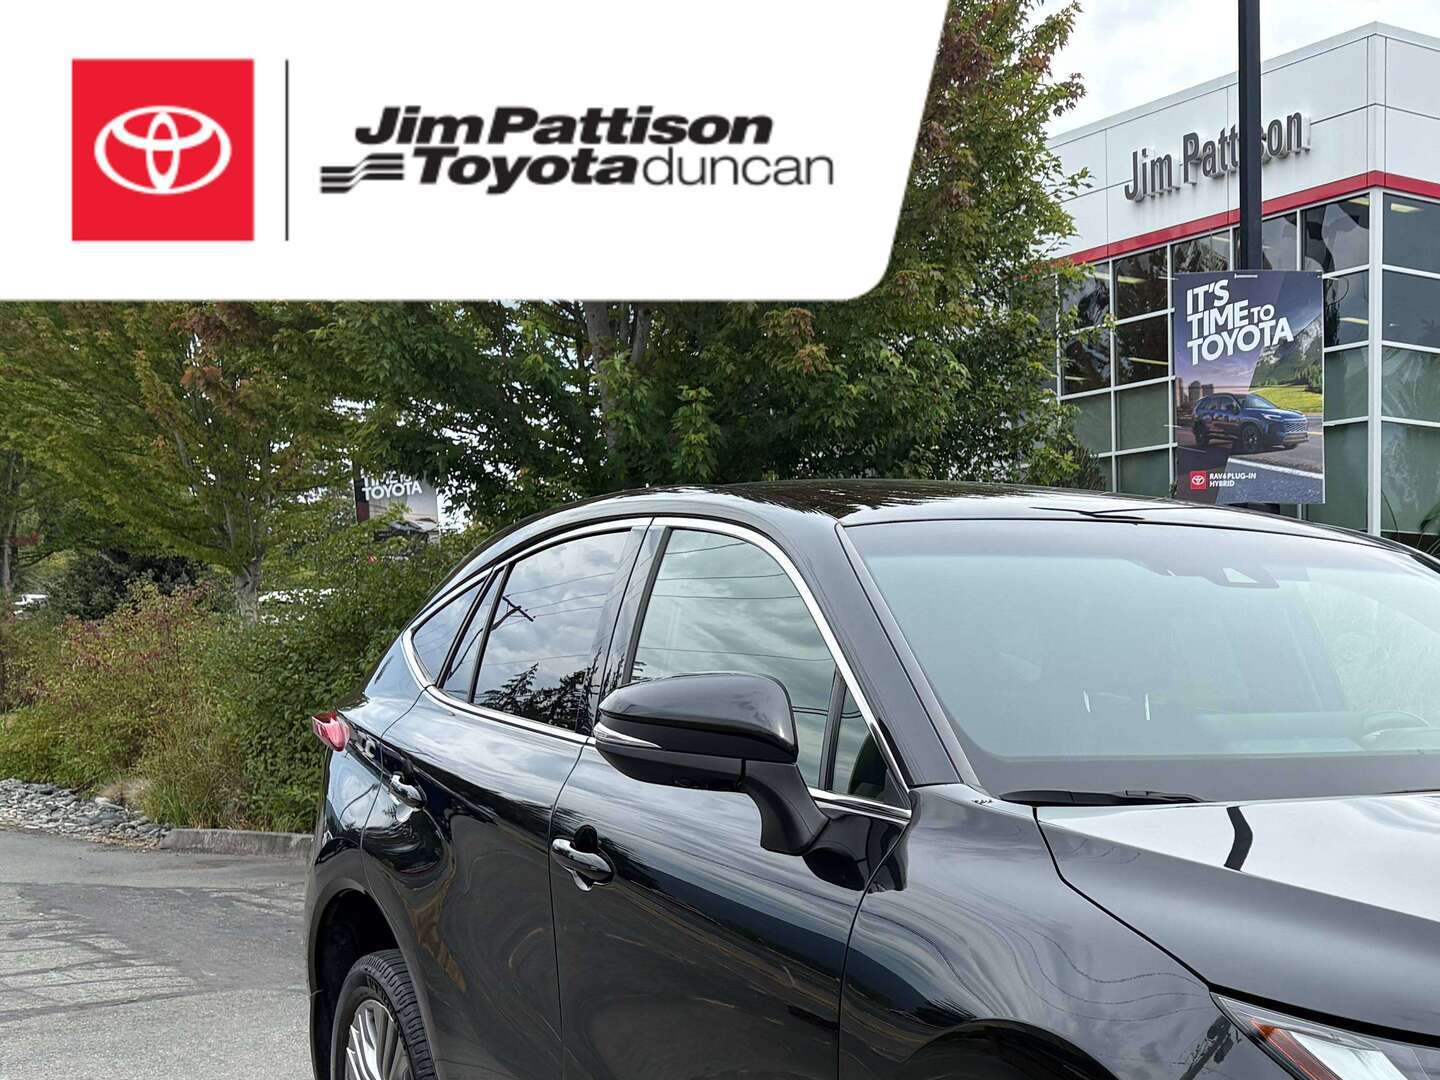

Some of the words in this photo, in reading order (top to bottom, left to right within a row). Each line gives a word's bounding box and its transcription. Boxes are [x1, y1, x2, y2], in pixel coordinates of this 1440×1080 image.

[1124, 148, 1175, 201] Jim
[1183, 111, 1305, 184] Patton
[1187, 279, 1230, 315] IT'S
[1187, 299, 1249, 340] TIME
[1250, 304, 1275, 321] TO
[1187, 317, 1295, 366] TOYOTA
[361, 480, 423, 501] TOYOTA
[1227, 472, 1257, 480] PLUG-IN
